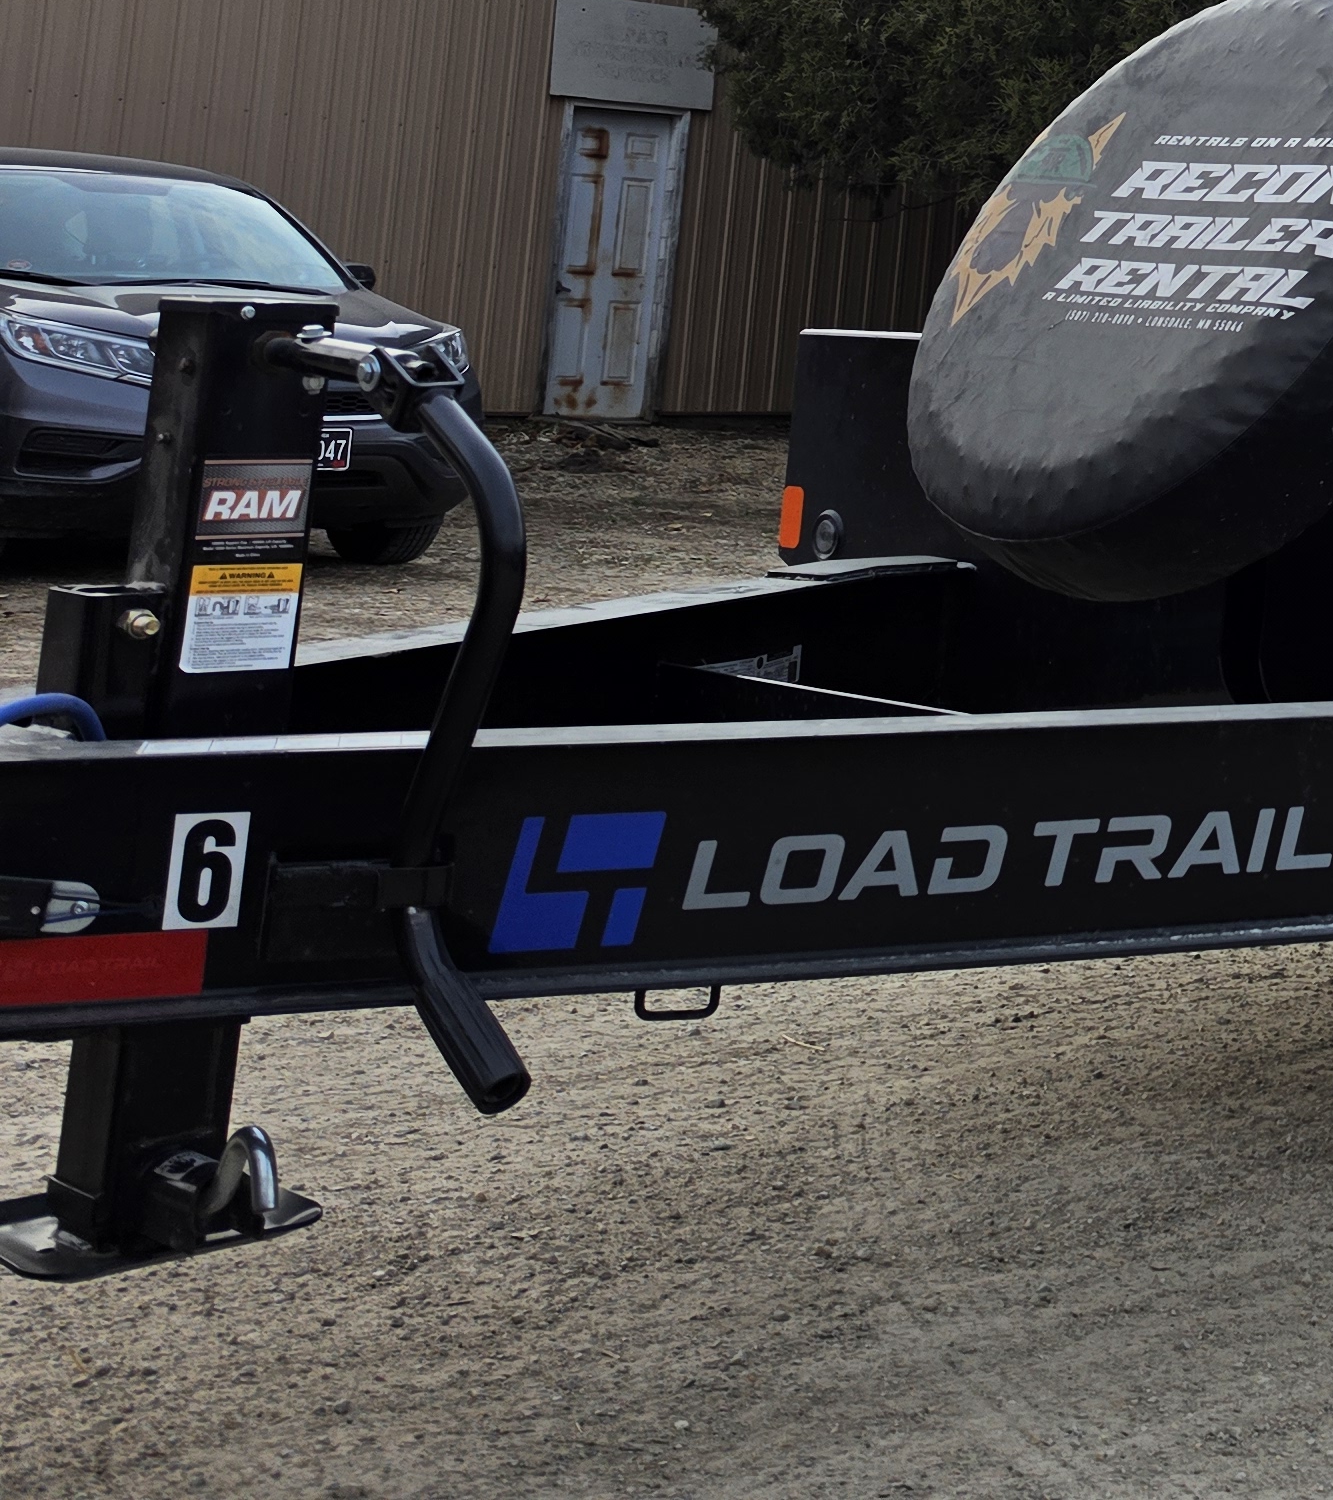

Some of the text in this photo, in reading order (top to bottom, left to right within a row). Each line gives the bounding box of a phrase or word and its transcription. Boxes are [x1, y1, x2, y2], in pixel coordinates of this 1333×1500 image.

[1154, 135, 1248, 147] RENTALS
[1250, 137, 1282, 148] ON
[1283, 137, 1302, 148] A
[1053, 257, 1315, 310] RENTAL
[1055, 293, 1125, 307] LIMITED
[1126, 298, 1204, 312] LIABILITY
[1205, 303, 1295, 320] COMPANY
[204, 490, 302, 520] RAM
[177, 819, 236, 923] 6
[682, 824, 1006, 911] LOAD
[1033, 806, 1333, 887] TRAIL
